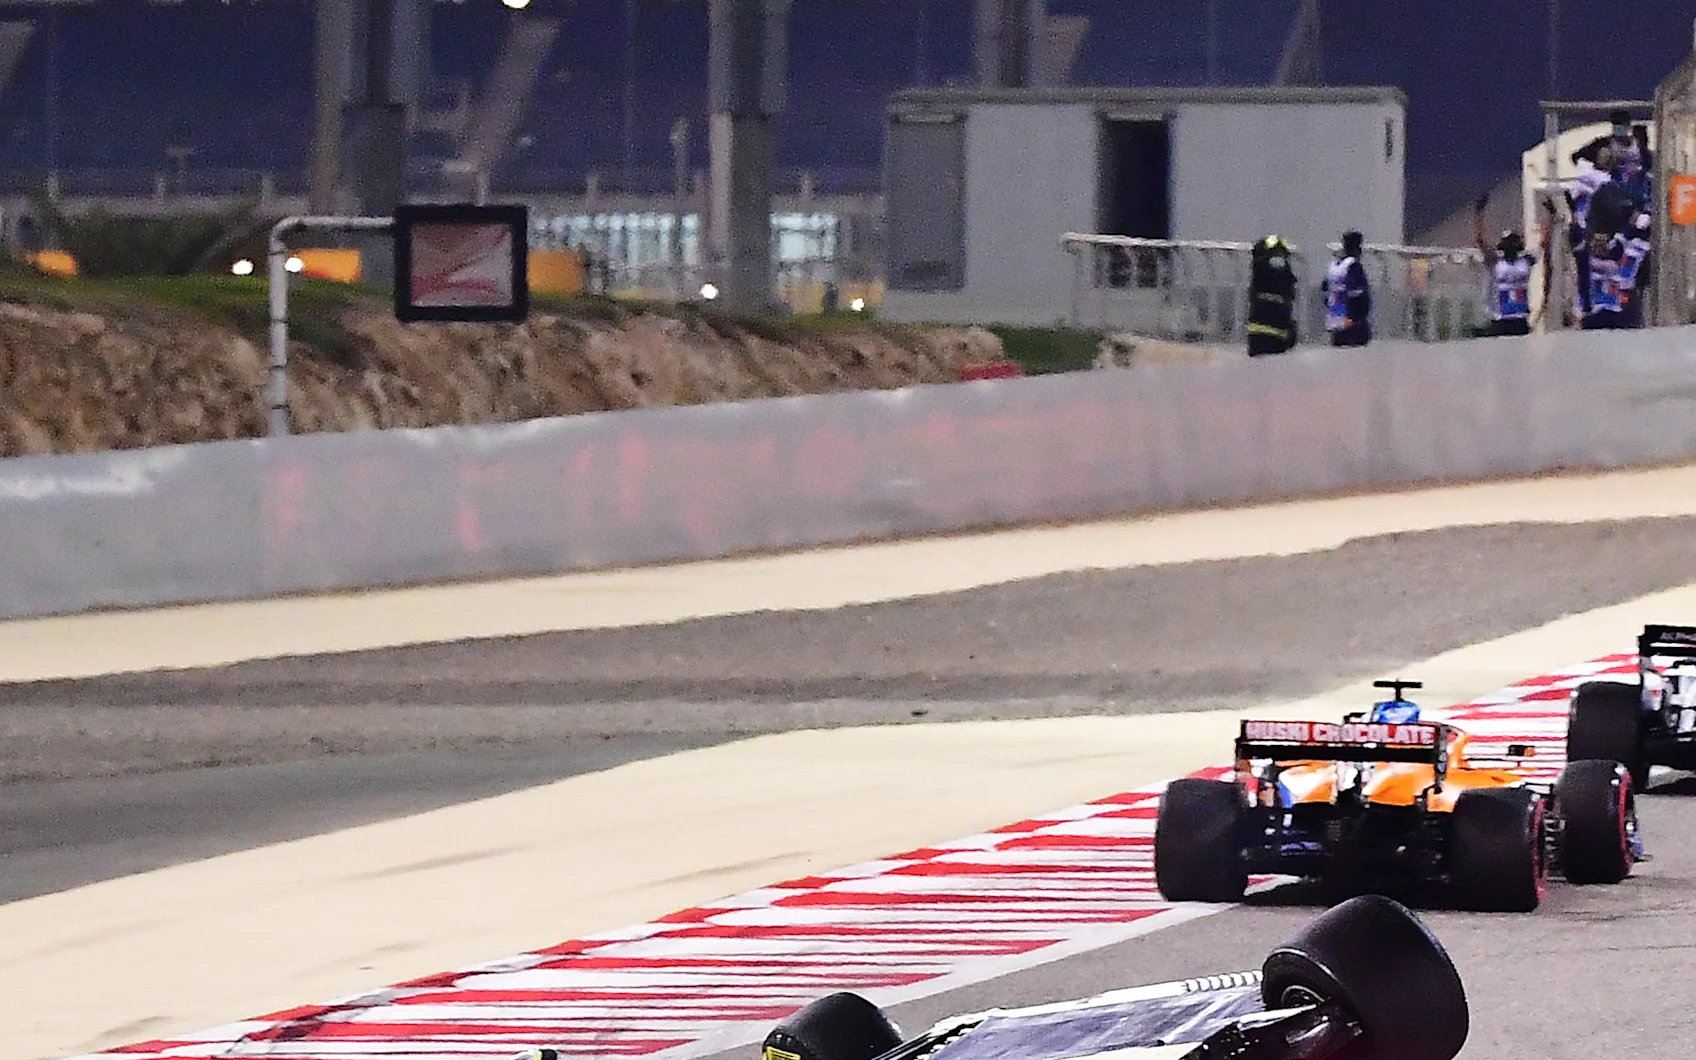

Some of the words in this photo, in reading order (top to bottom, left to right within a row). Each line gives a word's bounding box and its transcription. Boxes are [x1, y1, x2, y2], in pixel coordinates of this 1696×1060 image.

[1676, 183, 1696, 215] F
[1246, 721, 1309, 741] HUSKI
[1313, 724, 1434, 744] CHOCOLATE
